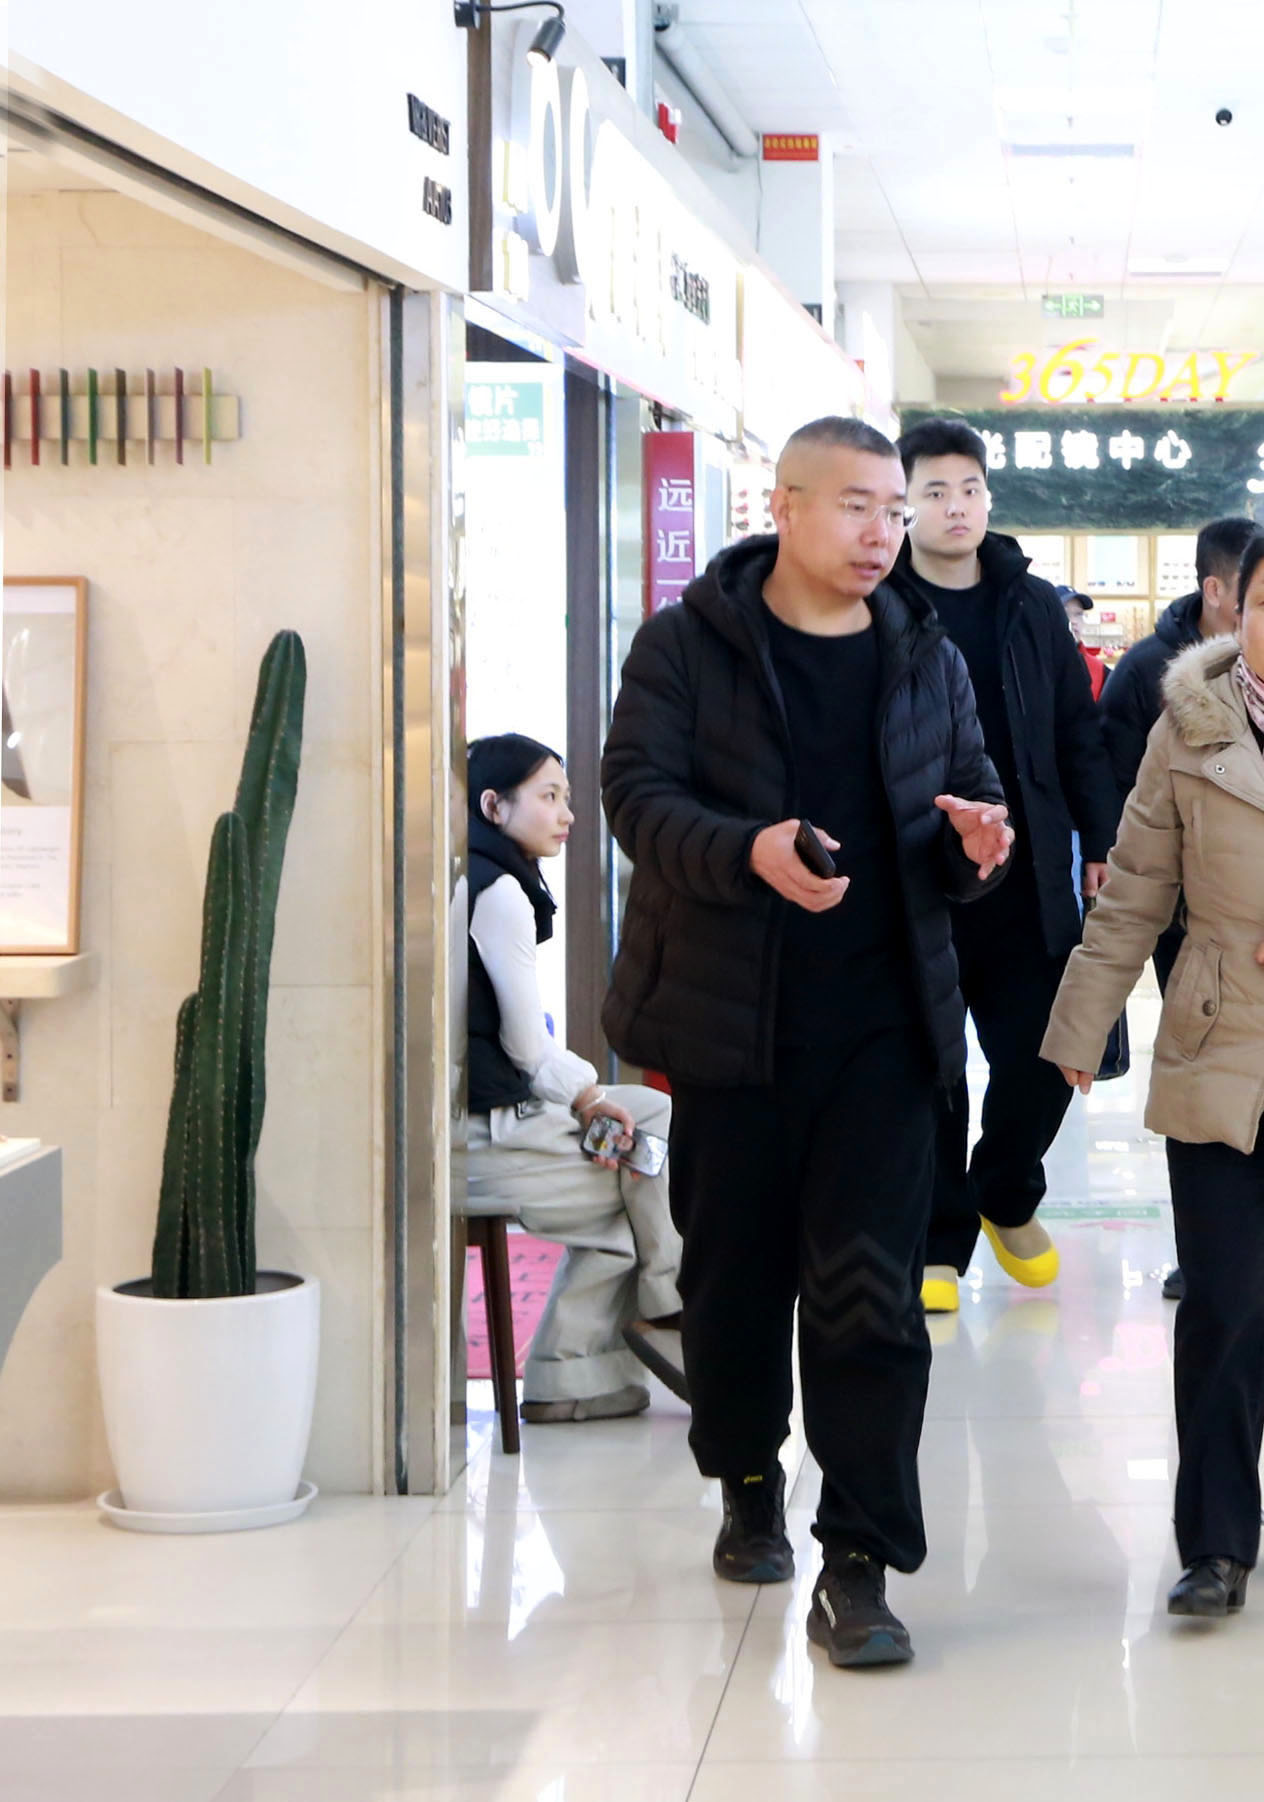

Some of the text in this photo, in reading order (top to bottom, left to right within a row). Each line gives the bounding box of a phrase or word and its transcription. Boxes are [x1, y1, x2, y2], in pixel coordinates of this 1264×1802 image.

[999, 338, 1258, 401] 365DAY
[656, 478, 693, 611] 远近一
